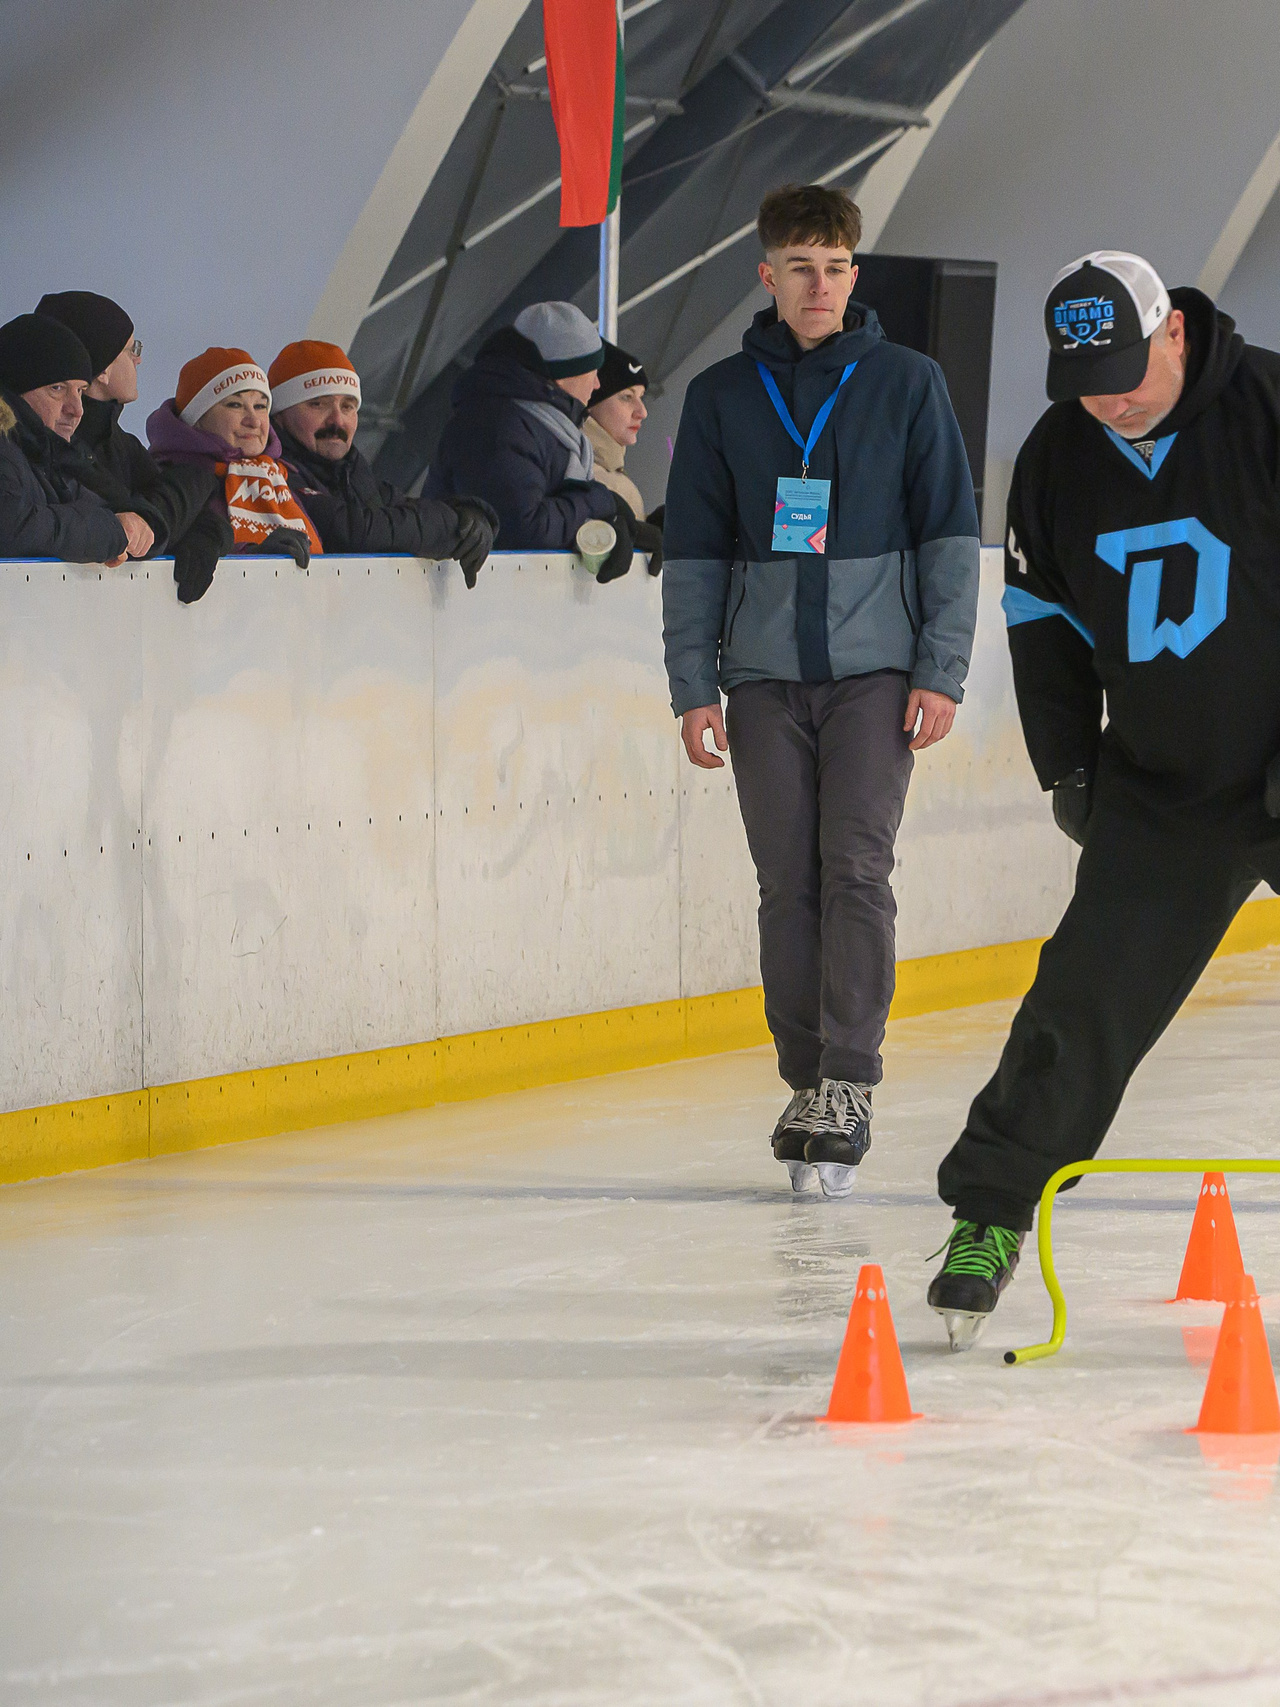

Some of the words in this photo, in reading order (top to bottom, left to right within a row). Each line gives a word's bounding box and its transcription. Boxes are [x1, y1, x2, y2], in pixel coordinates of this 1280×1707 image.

[1054, 304, 1114, 323] DINAMO
[213, 370, 266, 396] БЕЛАРУСЬ
[303, 375, 358, 390] БЕЛАРУСЬ
[791, 513, 811, 521] СУДЬЯ
